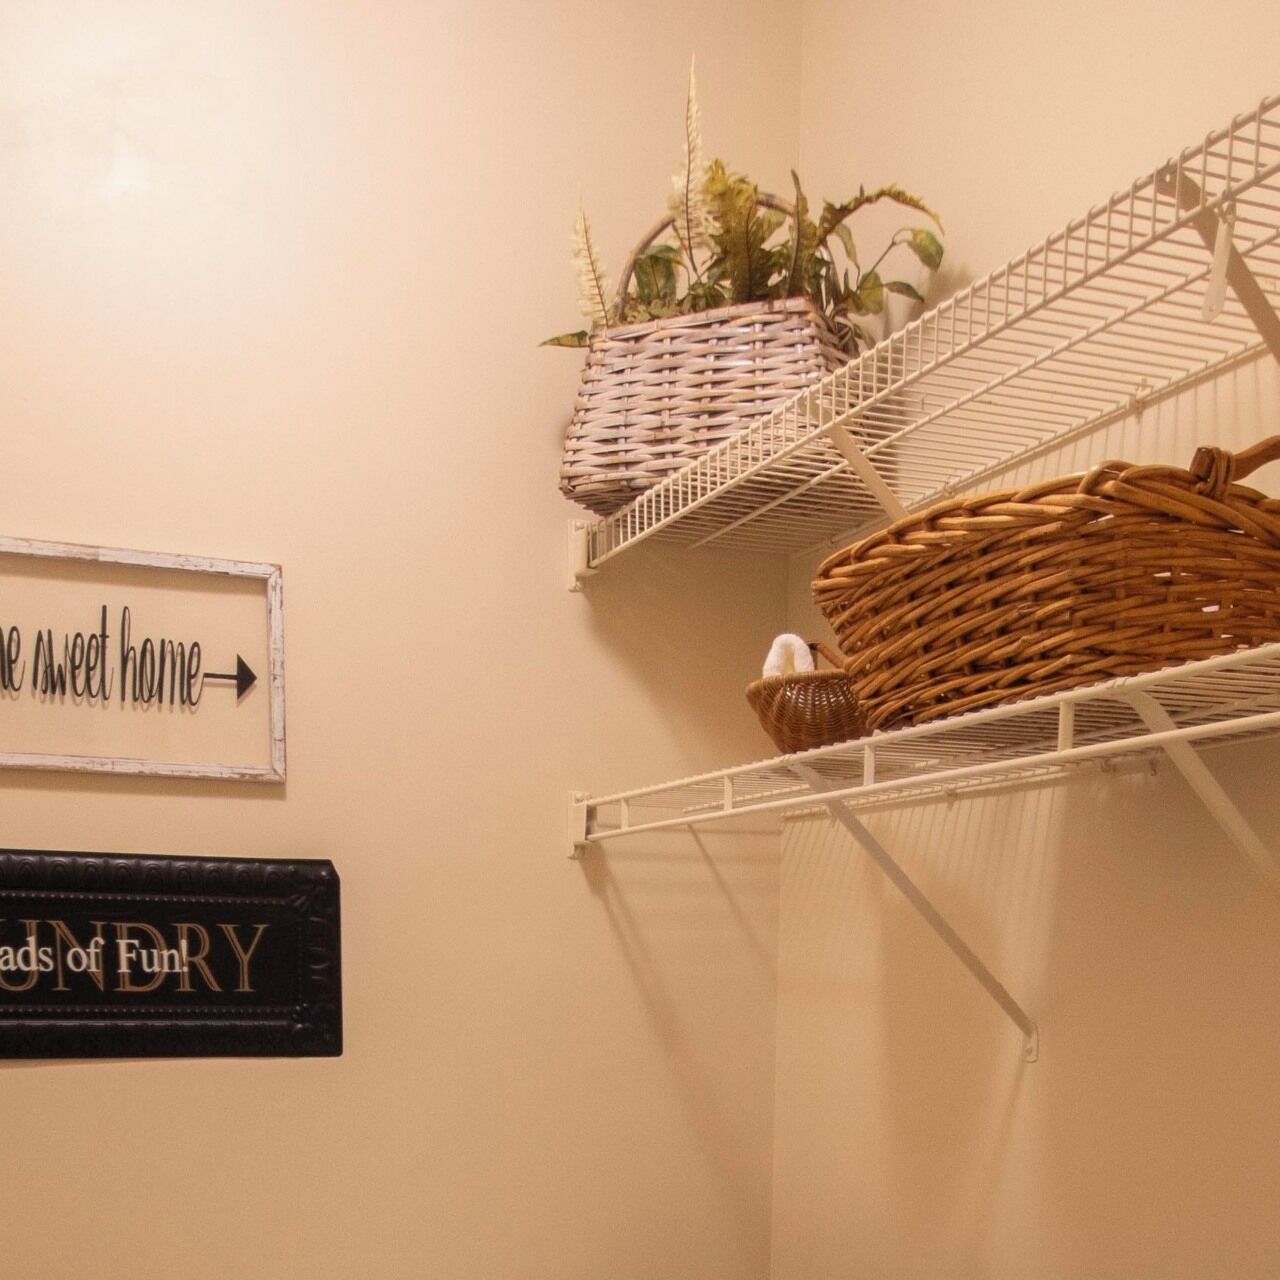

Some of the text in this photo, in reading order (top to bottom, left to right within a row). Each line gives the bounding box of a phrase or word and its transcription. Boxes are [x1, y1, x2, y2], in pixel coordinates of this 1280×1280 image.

[32, 604, 114, 700] sweet
[121, 606, 205, 706] home
[66, 937, 105, 972] of
[116, 939, 189, 973] Fun!
